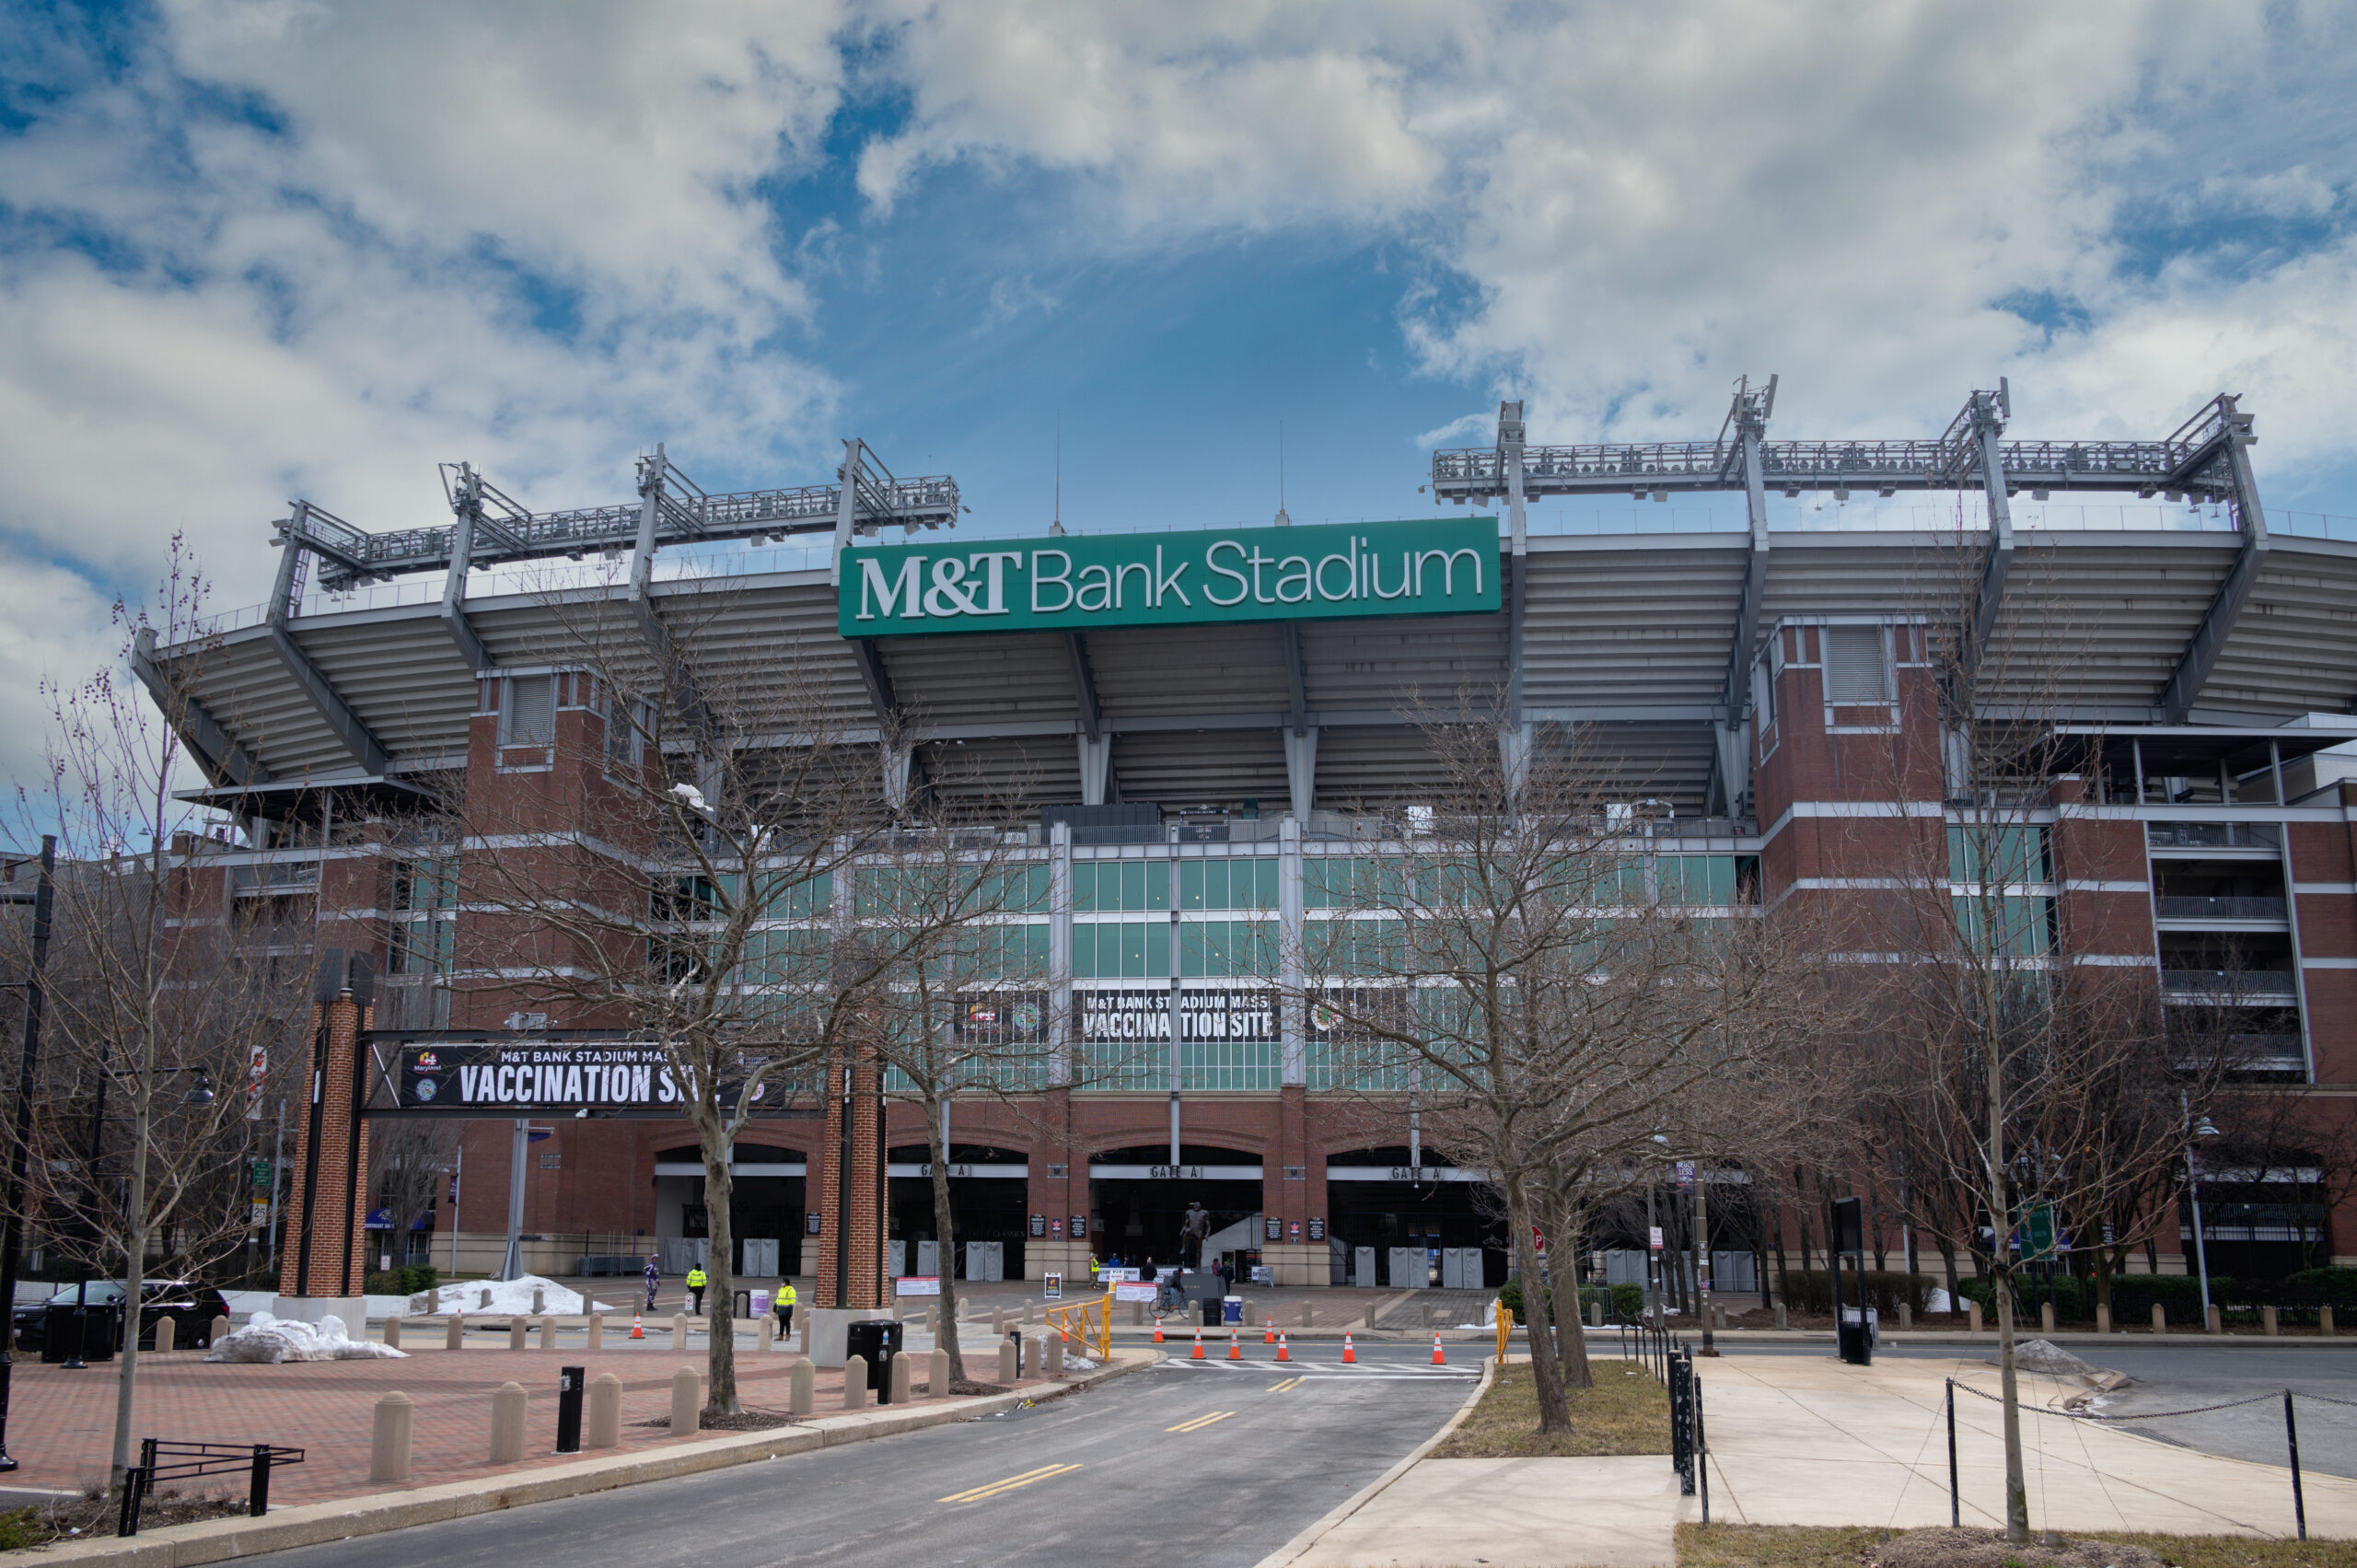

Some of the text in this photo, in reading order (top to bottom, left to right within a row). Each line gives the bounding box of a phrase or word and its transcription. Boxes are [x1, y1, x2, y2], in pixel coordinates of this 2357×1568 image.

[855, 535, 1483, 621] M&T Bank Stadium
[1086, 996, 1114, 1010] M&T
[1117, 996, 1152, 1009] BANK
[1155, 996, 1225, 1010] STADIUM
[1082, 1012, 1273, 1038] VACCINATION SITE
[501, 1051, 529, 1063] M&T
[533, 1051, 572, 1063] BANK
[575, 1051, 637, 1063] STADIUM
[413, 1064, 442, 1074] Maryland
[460, 1064, 652, 1102] VACCINATION
[958, 1165, 965, 1176] A
[1151, 1166, 1198, 1178] GATE A
[1392, 1167, 1440, 1179] GATE A
[254, 1207, 266, 1218] 25
